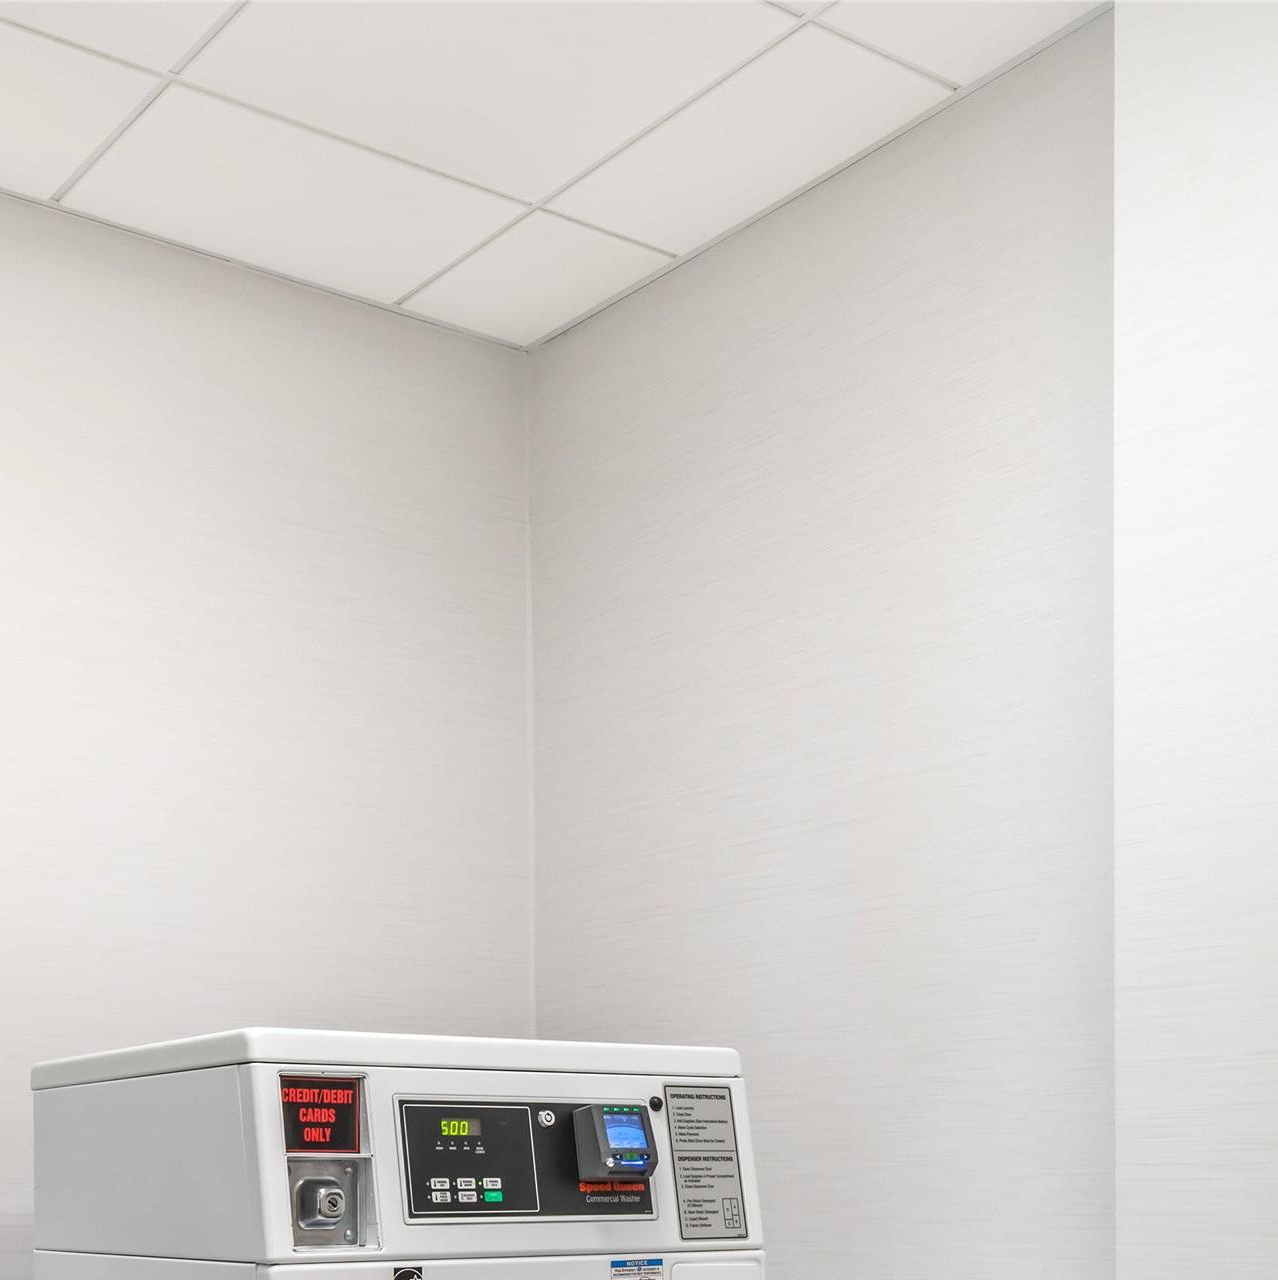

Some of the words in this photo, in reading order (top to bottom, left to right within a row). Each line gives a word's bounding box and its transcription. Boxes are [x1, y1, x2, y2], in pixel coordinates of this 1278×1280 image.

[283, 1087, 353, 1104] CREDIT/DEBIT
[299, 1108, 336, 1123] CARDS
[304, 1128, 331, 1142] ONLY
[441, 1121, 468, 1135] 500
[579, 1183, 611, 1193] Speed
[613, 1183, 645, 1191] Queen
[586, 1195, 619, 1203] Commercial
